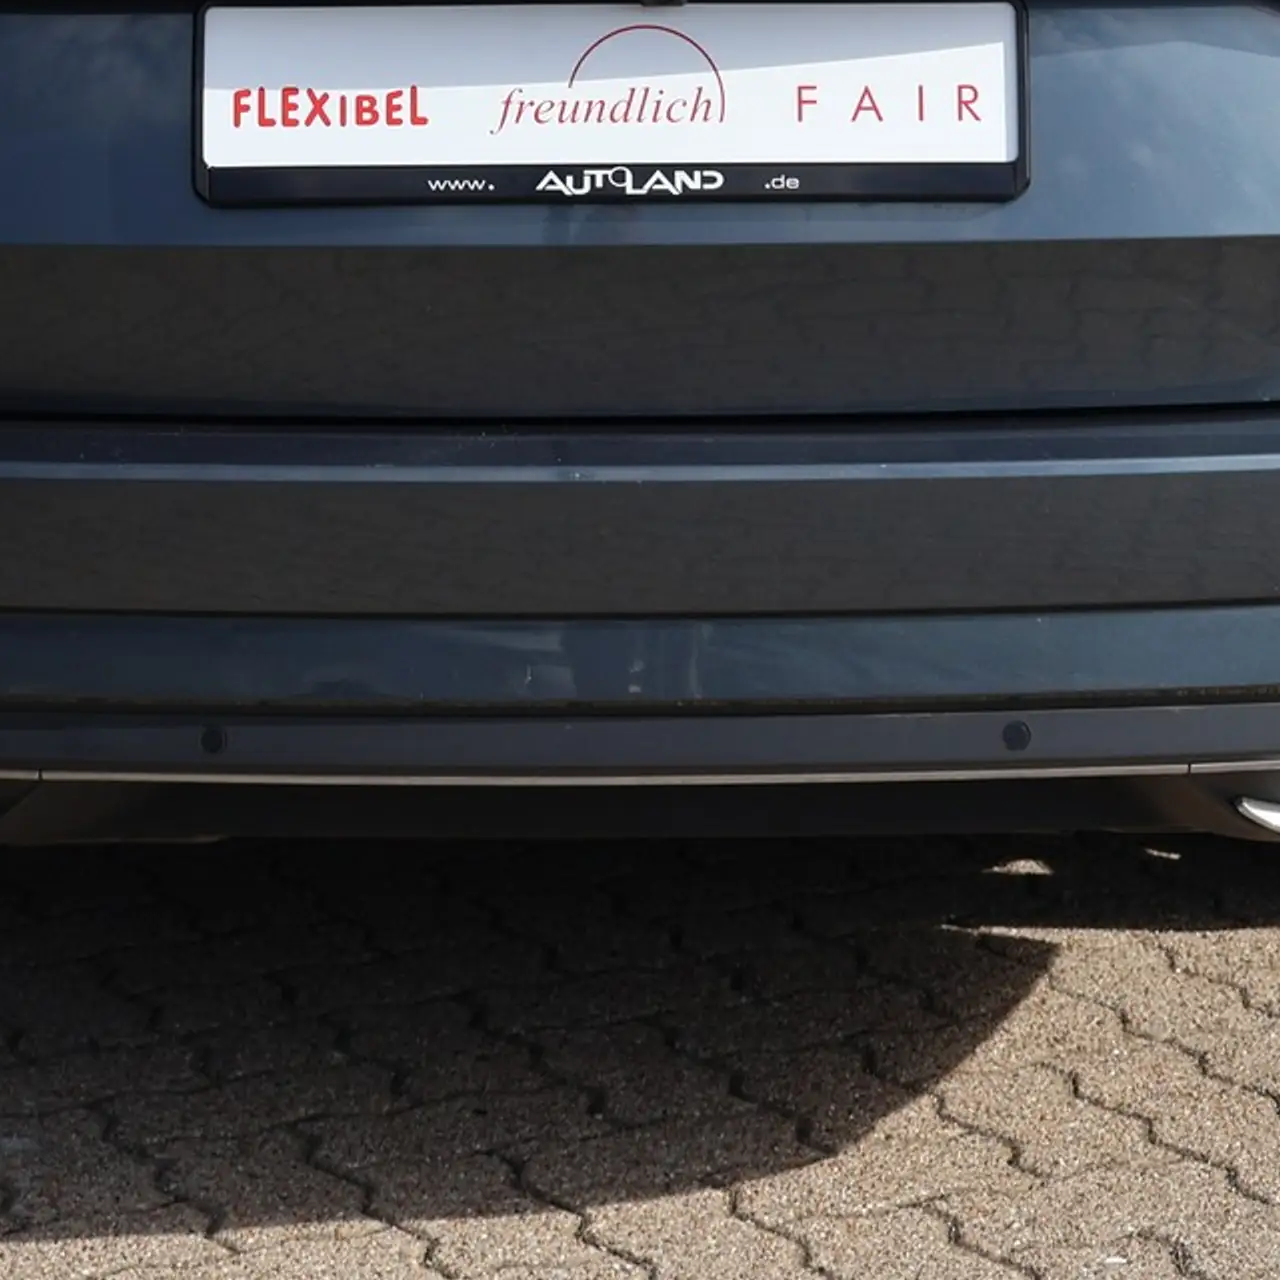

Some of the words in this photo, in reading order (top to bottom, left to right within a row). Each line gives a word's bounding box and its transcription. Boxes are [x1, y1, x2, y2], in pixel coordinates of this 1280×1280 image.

[232, 84, 430, 130] FLEXIBEL
[490, 84, 717, 136] freundlich
[796, 83, 982, 123] FAIR
[428, 177, 495, 192] www.
[536, 166, 725, 196] AUTOLAND
[765, 174, 800, 191] .de
